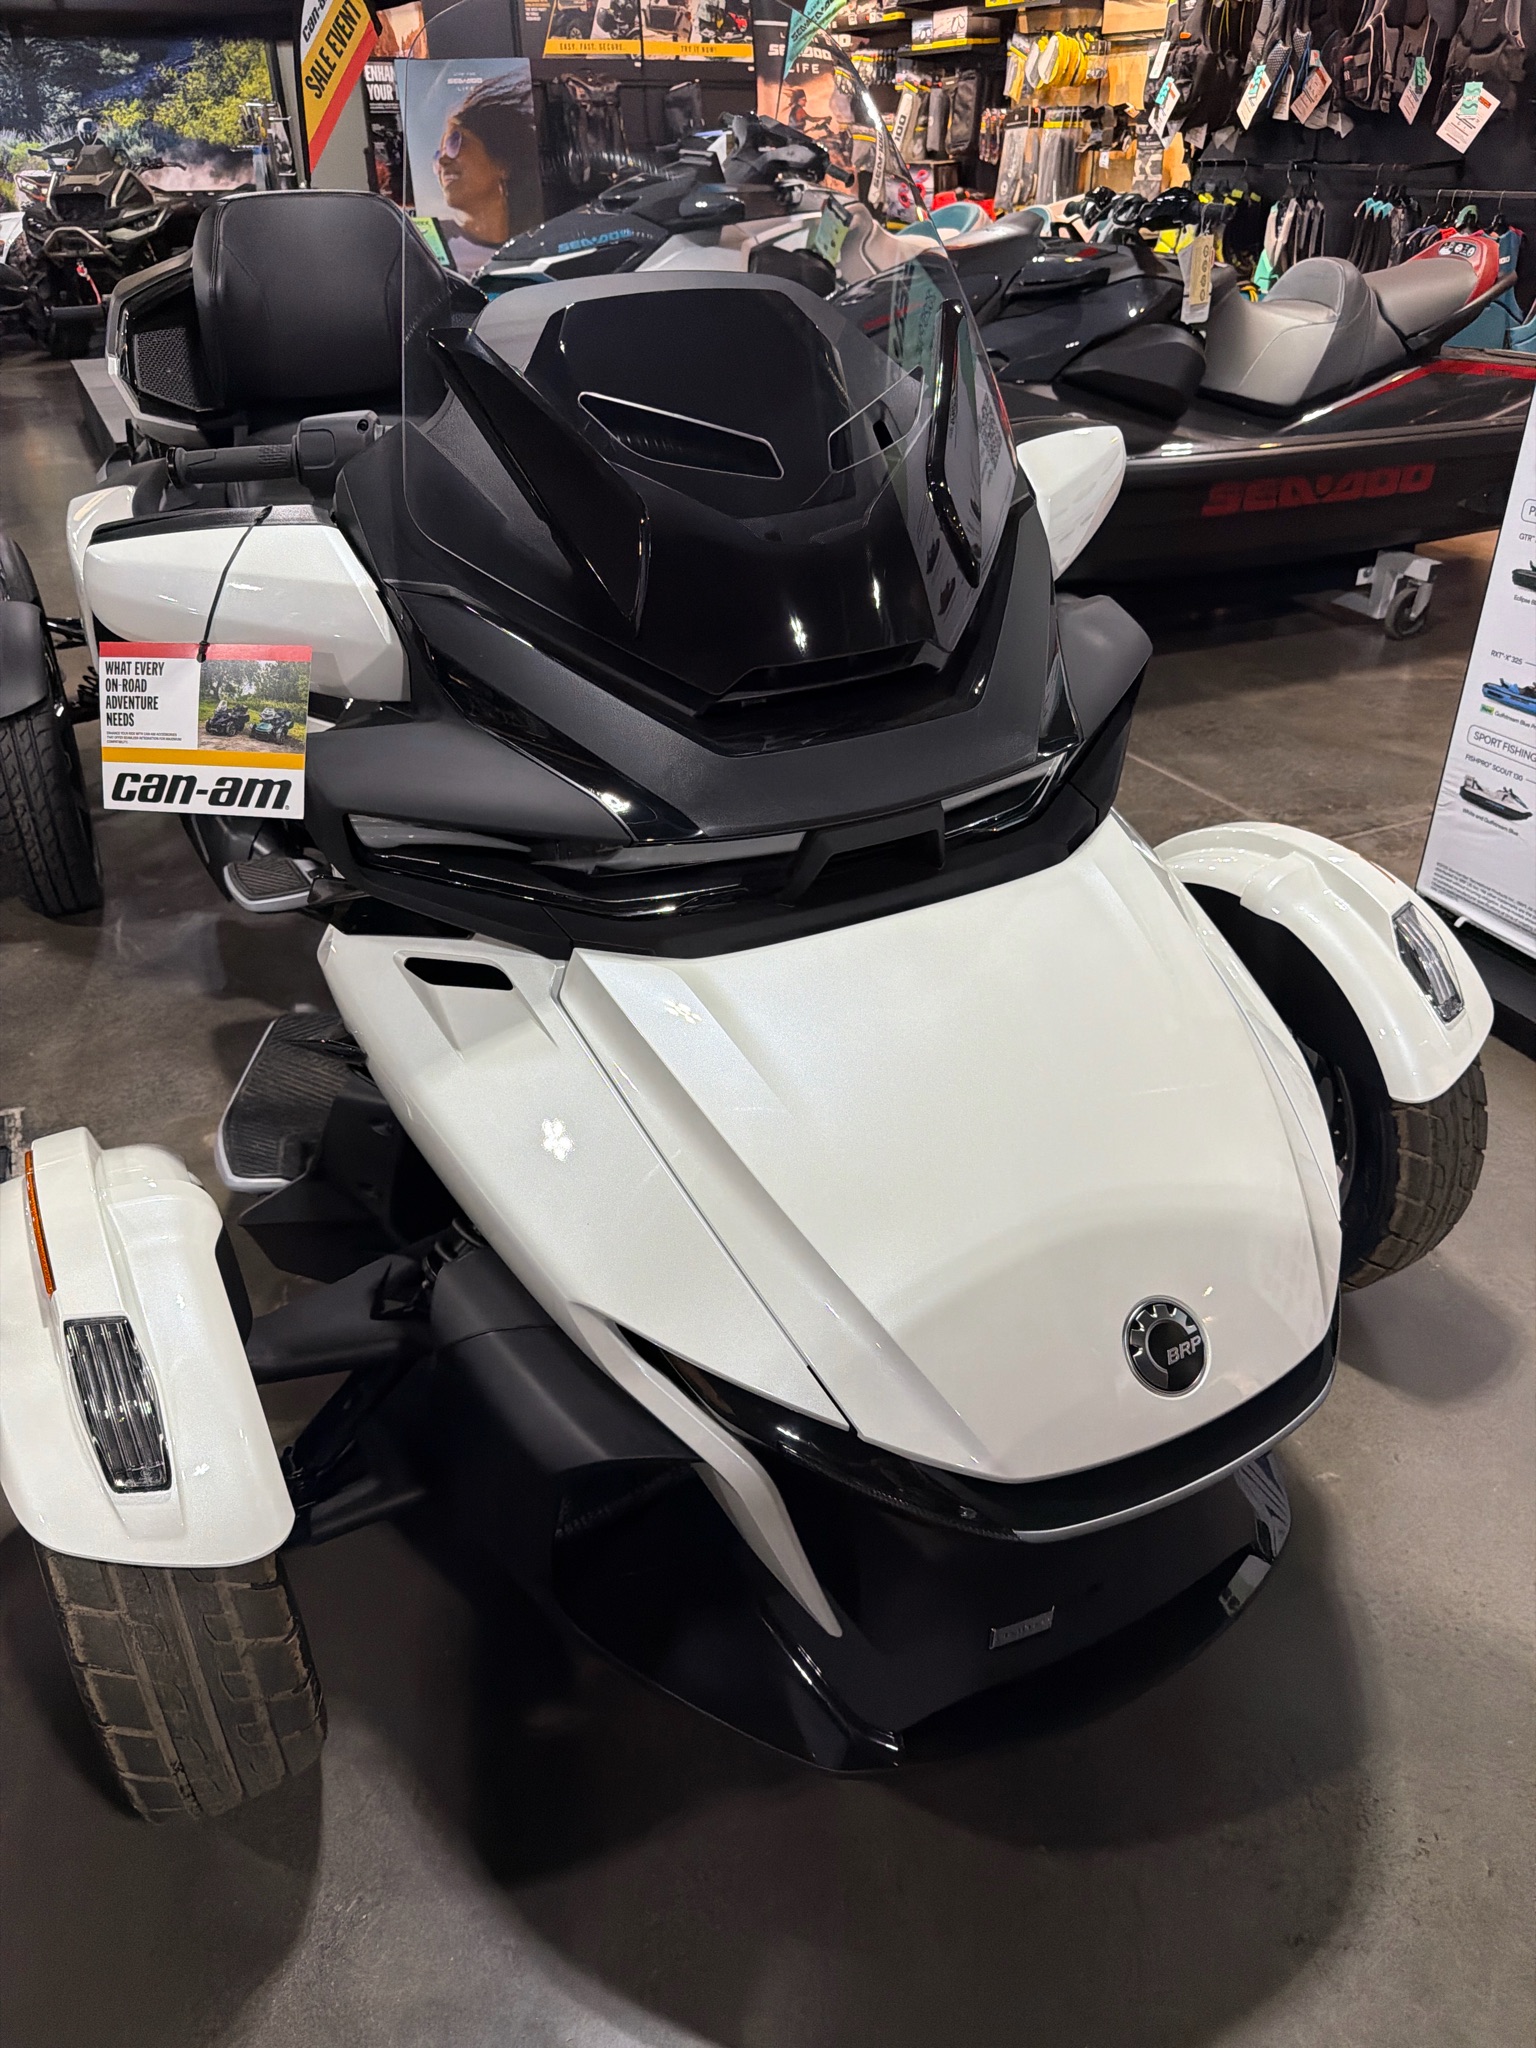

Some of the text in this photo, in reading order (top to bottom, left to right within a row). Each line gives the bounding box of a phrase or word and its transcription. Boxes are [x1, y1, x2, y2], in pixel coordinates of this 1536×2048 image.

[305, 0, 361, 99] SALE EVENT
[367, 84, 395, 101] YOUR
[105, 661, 165, 676] WHAT EVERY
[105, 678, 147, 692] ON-ROAD
[105, 695, 159, 710] ADVENTURE
[106, 712, 134, 726] NEEDS
[1473, 731, 1536, 763] SPORT FISHING
[1491, 764, 1513, 777] SCOUT
[1513, 773, 1524, 782] 130
[1167, 1335, 1201, 1365] BRP
